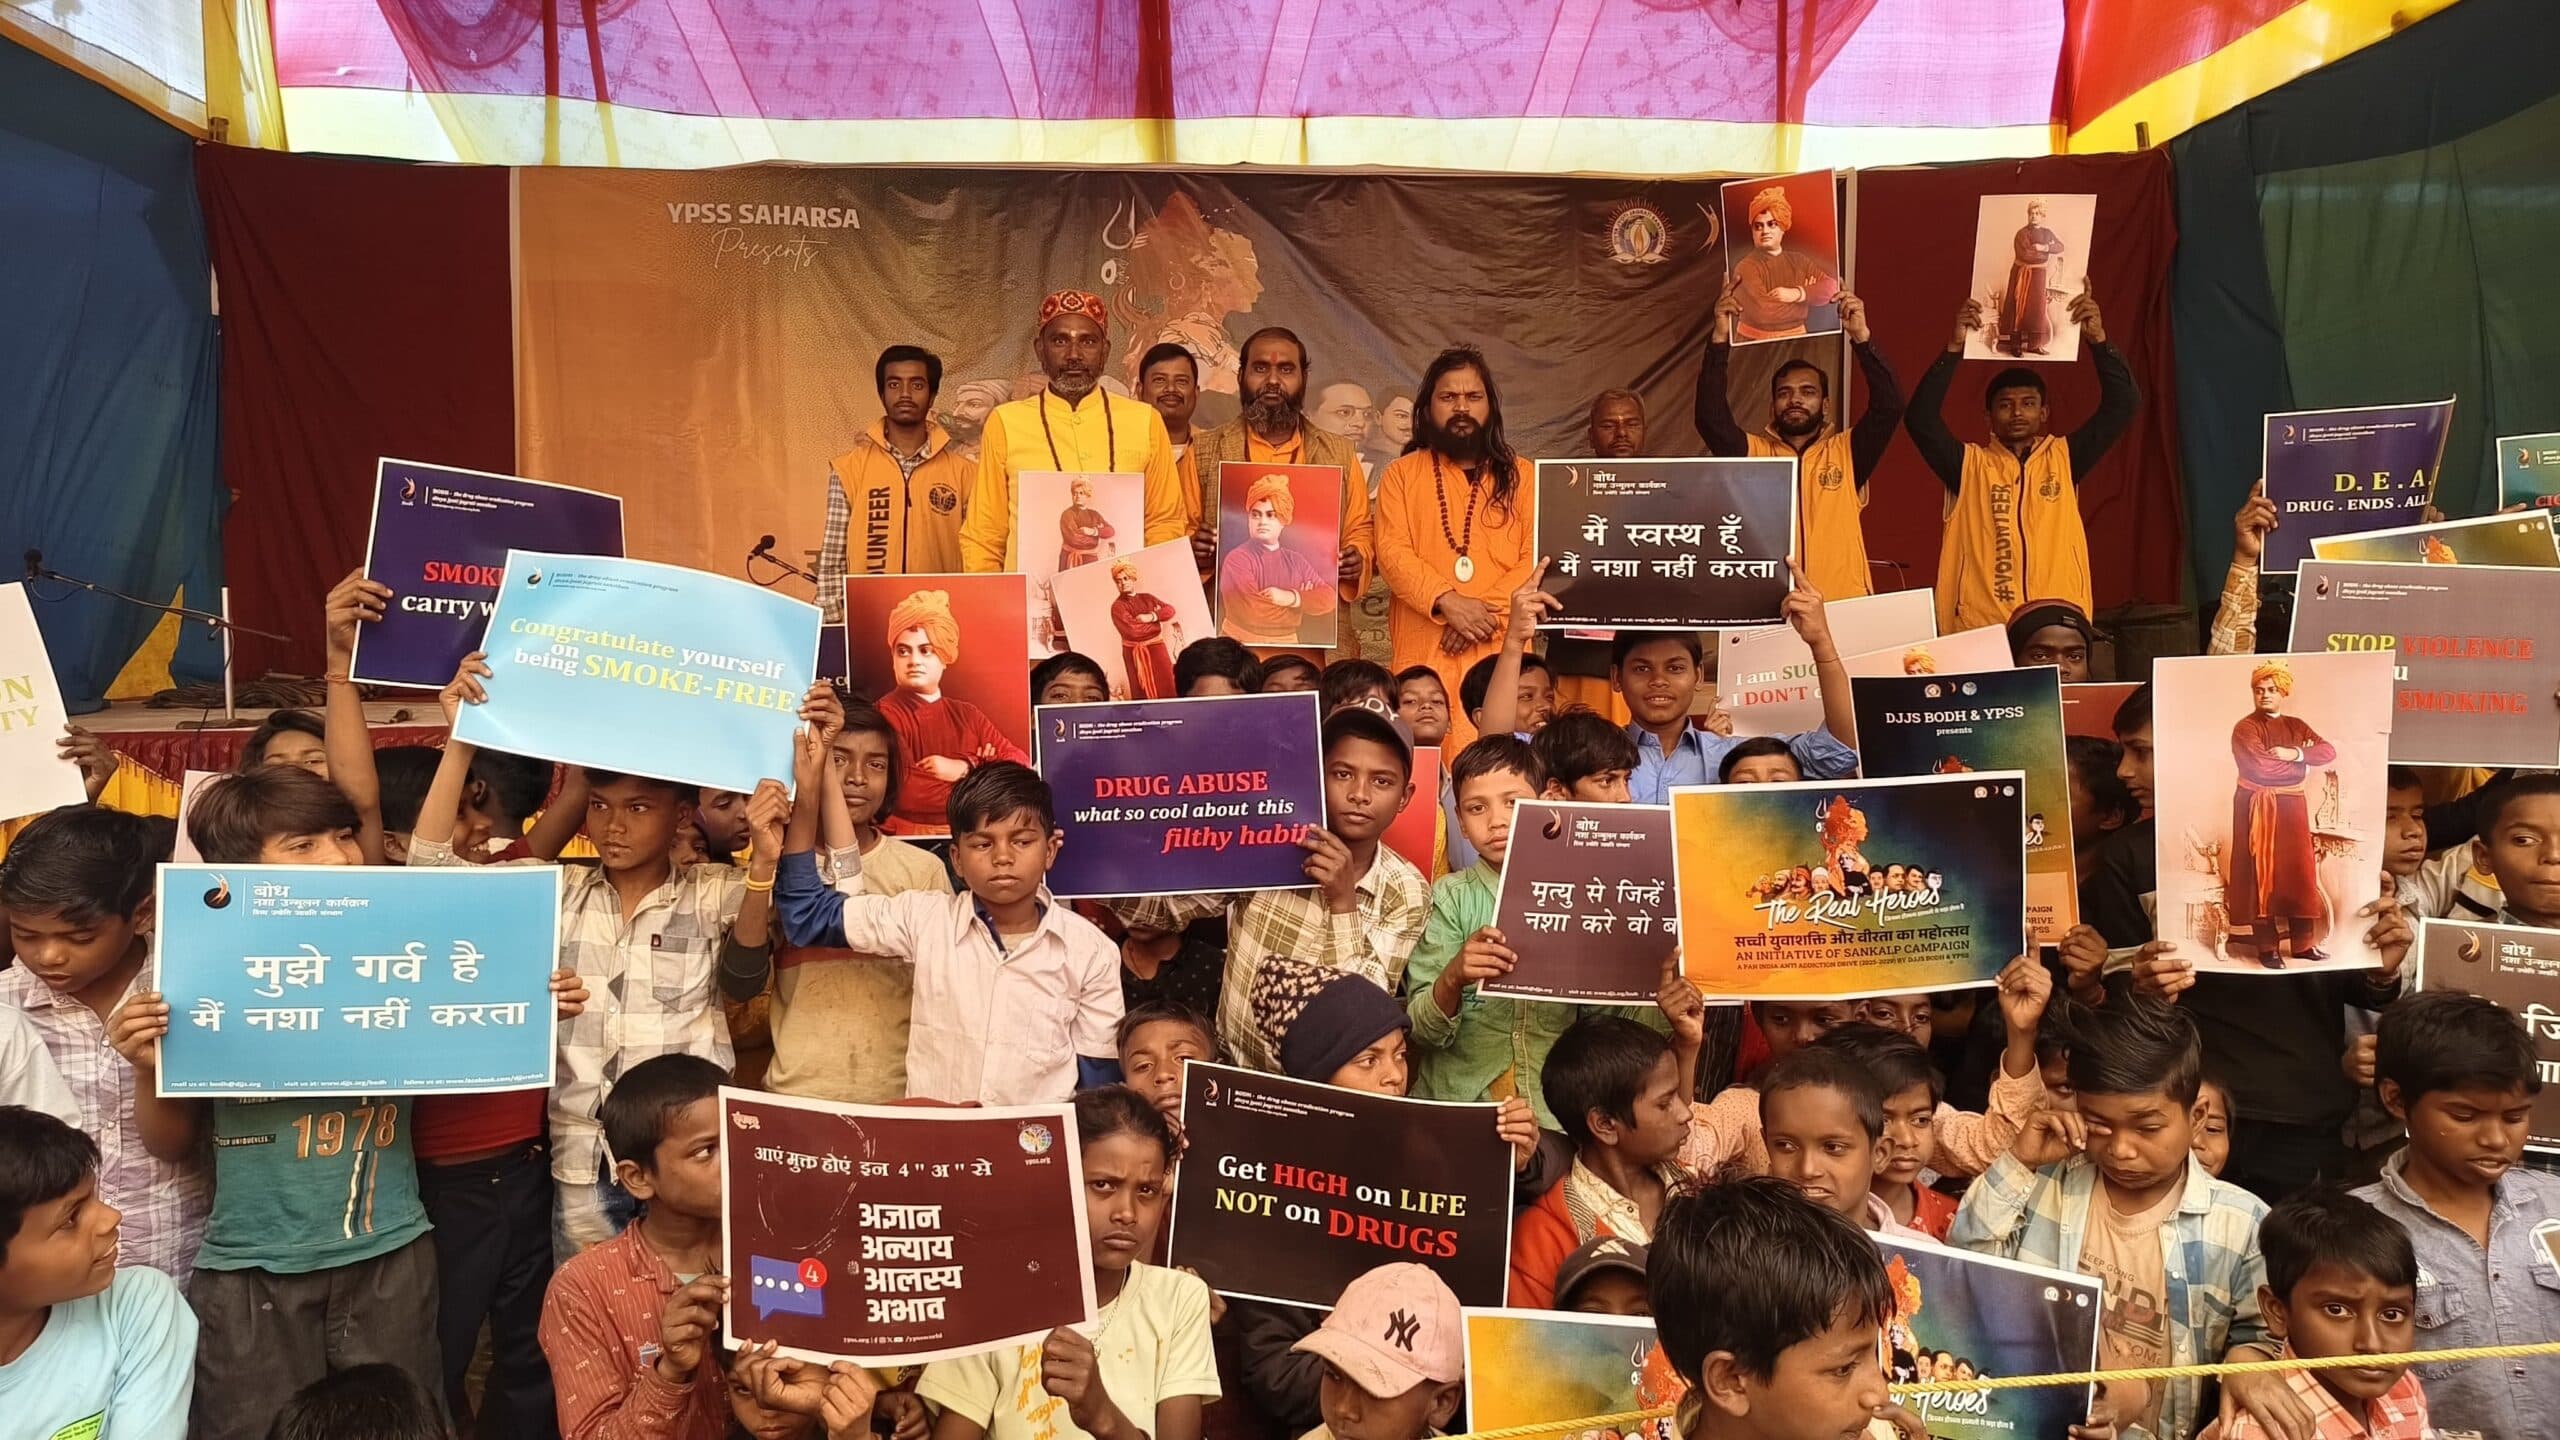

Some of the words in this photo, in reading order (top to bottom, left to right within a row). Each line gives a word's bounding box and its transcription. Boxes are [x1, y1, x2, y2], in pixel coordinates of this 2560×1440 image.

[667, 203, 732, 224] YPSS
[739, 207, 861, 229] SAHARSA
[711, 227, 828, 272] Presents
[2286, 501, 2335, 513] DRUG
[2347, 498, 2395, 511] ENDS
[1581, 514, 1609, 547] मैं
[1624, 523, 1705, 548] स्वस्थ
[1717, 513, 1745, 555] हूँ
[423, 560, 504, 587] SMOK
[1558, 551, 1581, 578] मैं
[1591, 559, 1642, 578] नशा
[1651, 553, 1698, 579] नहीं
[1708, 559, 1779, 579] करता
[401, 595, 476, 620] carry
[510, 617, 675, 658] Congratulate
[680, 646, 785, 680] yourself
[551, 640, 580, 660] on
[2325, 633, 2396, 653] STOP
[2402, 633, 2536, 661] VIOLENCE
[0, 675, 34, 703] N
[513, 648, 580, 678] being
[582, 654, 797, 714] SMOKE-FREE
[1747, 670, 1778, 684] am
[1886, 710, 1922, 724] DJJS
[1925, 708, 1969, 722] BODH
[1971, 708, 1981, 721] &
[1983, 706, 2025, 720] YPSS
[2397, 688, 2529, 716] SMOKING
[1936, 725, 1973, 737] presents
[1095, 775, 1171, 798] DRUG
[1177, 771, 1268, 796] ABUSE
[1074, 806, 1122, 823] what
[1124, 807, 1146, 821] so
[1149, 803, 1188, 821] cool
[1192, 800, 1249, 819] about
[1257, 798, 1295, 816] this
[1161, 827, 1233, 854] filthy
[1239, 823, 1311, 846] habit
[253, 881, 291, 898] बोध
[1531, 880, 1576, 909] मृत्यु
[1586, 876, 1606, 904] से
[1616, 877, 1665, 906] जिन्हें
[1524, 911, 1571, 932] नशा
[1581, 907, 1617, 935] करे
[1627, 907, 1653, 936] वो
[1753, 899, 1800, 930] The
[1804, 890, 1862, 930] Real
[1866, 887, 1942, 928] Heroes
[1734, 932, 1766, 949] सच्ची
[1769, 931, 1827, 951] युवाशक्ति
[1830, 928, 1854, 945] और
[1857, 928, 1894, 944] वीरता
[1896, 928, 1916, 941] का
[1918, 924, 1970, 940] महोत्सव
[2033, 926, 2050, 934] PSS
[1736, 952, 1753, 961] AN
[1756, 949, 1822, 961] INITIATIVE
[1826, 948, 1841, 958] OF
[1843, 945, 1901, 958] SANKALP
[1903, 940, 1970, 954] CAMPAIGN
[2500, 940, 2535, 957] बोध
[243, 943, 331, 998] मुझे
[352, 942, 427, 985] गर्व
[449, 940, 485, 984] है
[189, 998, 225, 1032] मैं
[244, 1006, 325, 1032] नशा
[341, 998, 412, 1032] नहीं
[429, 1001, 530, 1027] करता
[292, 1103, 398, 1160] 1978
[754, 1145, 785, 1164] आएं
[787, 1152, 818, 1173] मुक्त
[821, 1153, 852, 1175] होएं
[859, 1160, 889, 1177] इन
[898, 1163, 909, 1177] 4
[932, 1164, 950, 1178] अ
[971, 1158, 992, 1176] से
[1218, 1156, 1267, 1183] Get
[1273, 1163, 1349, 1198] HIGH
[1356, 1184, 1392, 1207] on
[1399, 1188, 1467, 1217] LIFE
[859, 1203, 942, 1231] अज्ञान
[1215, 1188, 1279, 1217] NOT
[1285, 1203, 1321, 1225] on
[1328, 1208, 1458, 1258] DRUGS
[861, 1235, 954, 1262] अन्याय
[2082, 1252, 2105, 1266] KEEP
[804, 1264, 819, 1283] 4
[864, 1265, 964, 1293] आलस्य
[866, 1296, 947, 1324] अभाव
[1384, 1307, 1421, 1352] NY
